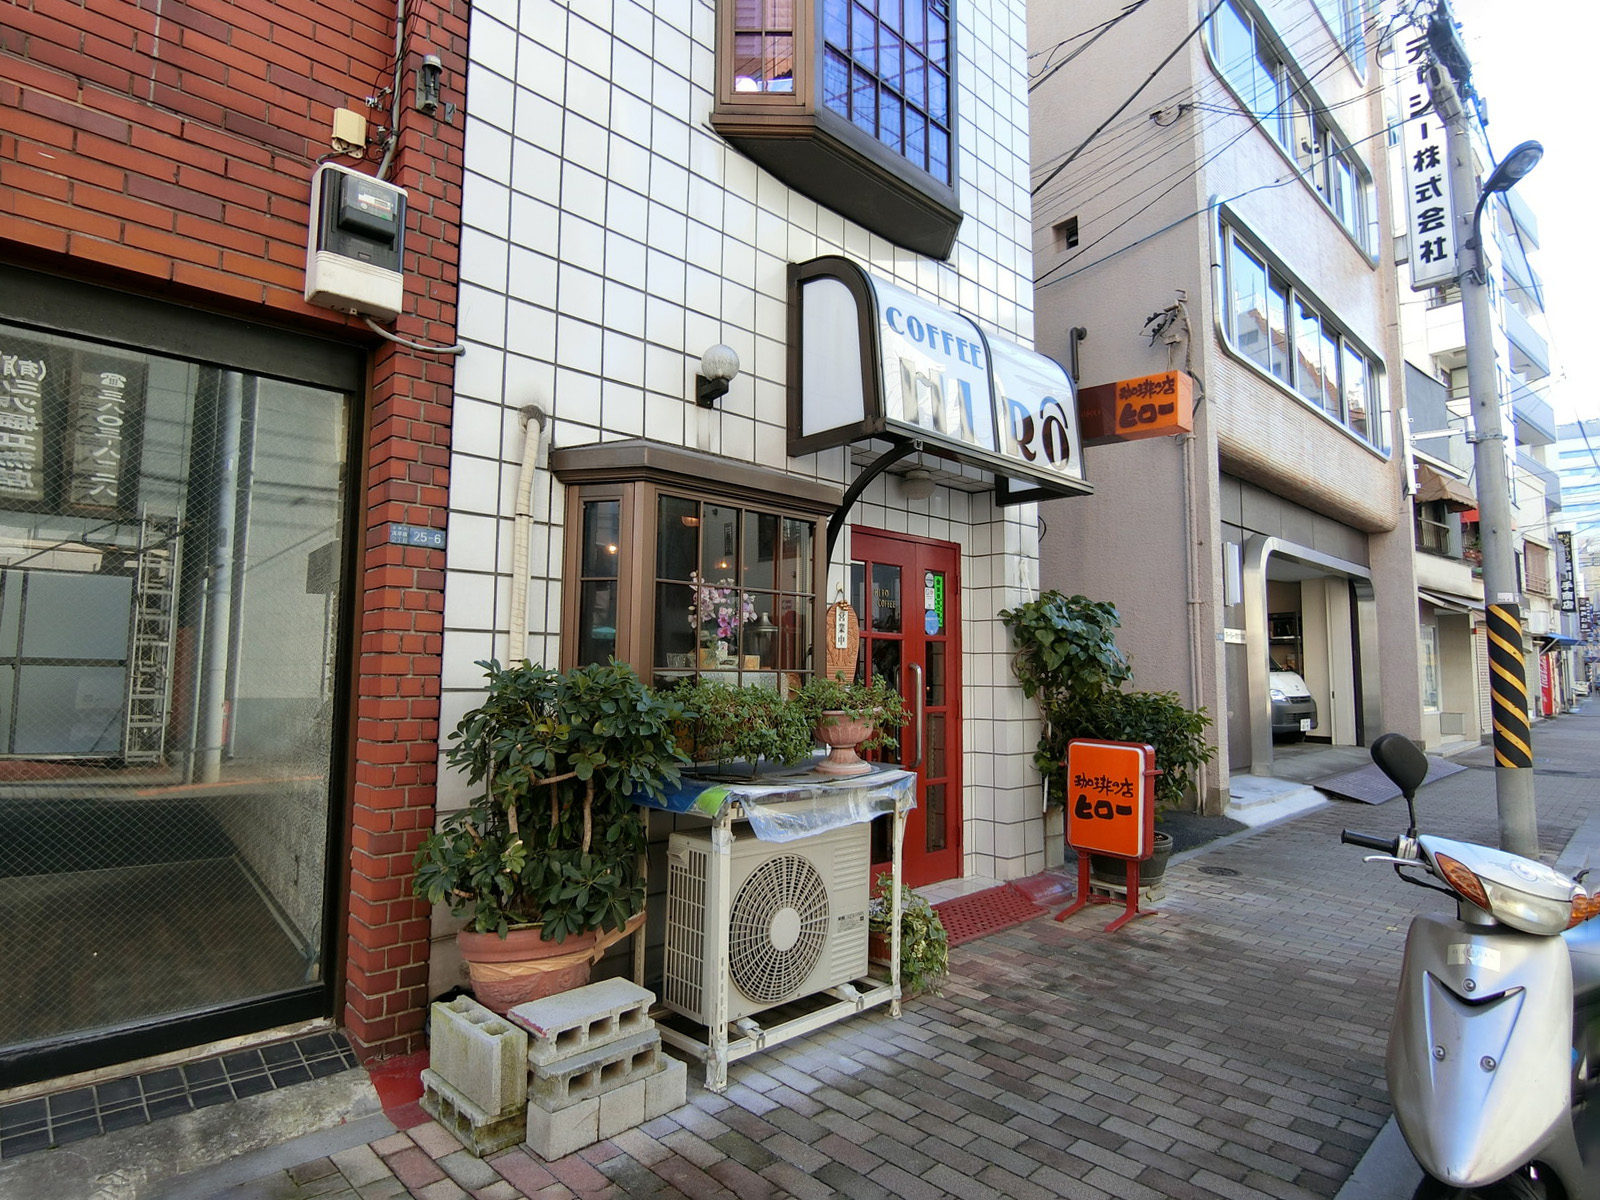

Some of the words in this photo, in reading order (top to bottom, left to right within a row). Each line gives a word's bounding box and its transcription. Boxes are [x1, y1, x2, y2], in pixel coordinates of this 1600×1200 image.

[886, 306, 984, 371] COFFEE
[1119, 375, 1175, 400] 珈琲の店
[1120, 402, 1175, 428] ヒロー
[413, 531, 442, 544] 25-6
[1074, 772, 1134, 798] 珈琲の店
[1075, 794, 1133, 820] ヒロー
